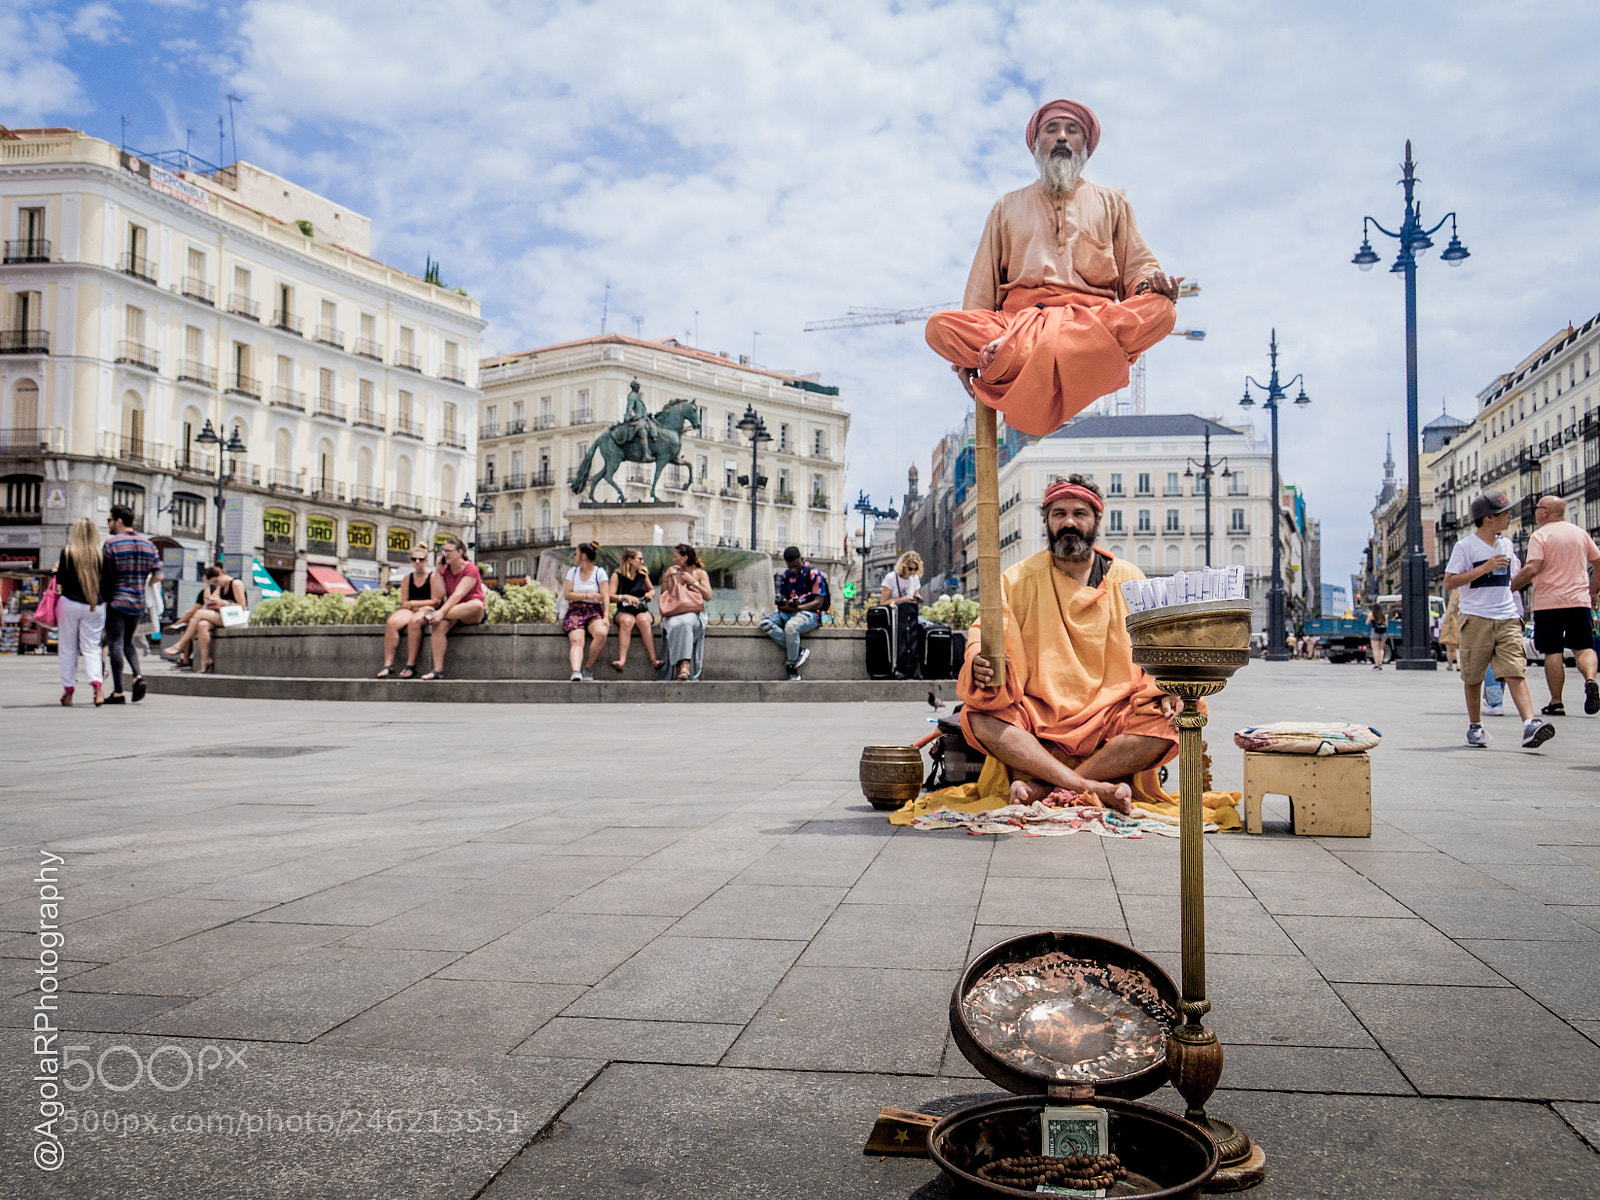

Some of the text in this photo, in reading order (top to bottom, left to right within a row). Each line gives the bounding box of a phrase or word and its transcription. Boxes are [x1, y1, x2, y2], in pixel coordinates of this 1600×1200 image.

[264, 519, 290, 536] ORO
[307, 526, 332, 541] ORO
[348, 532, 371, 546] ORO
